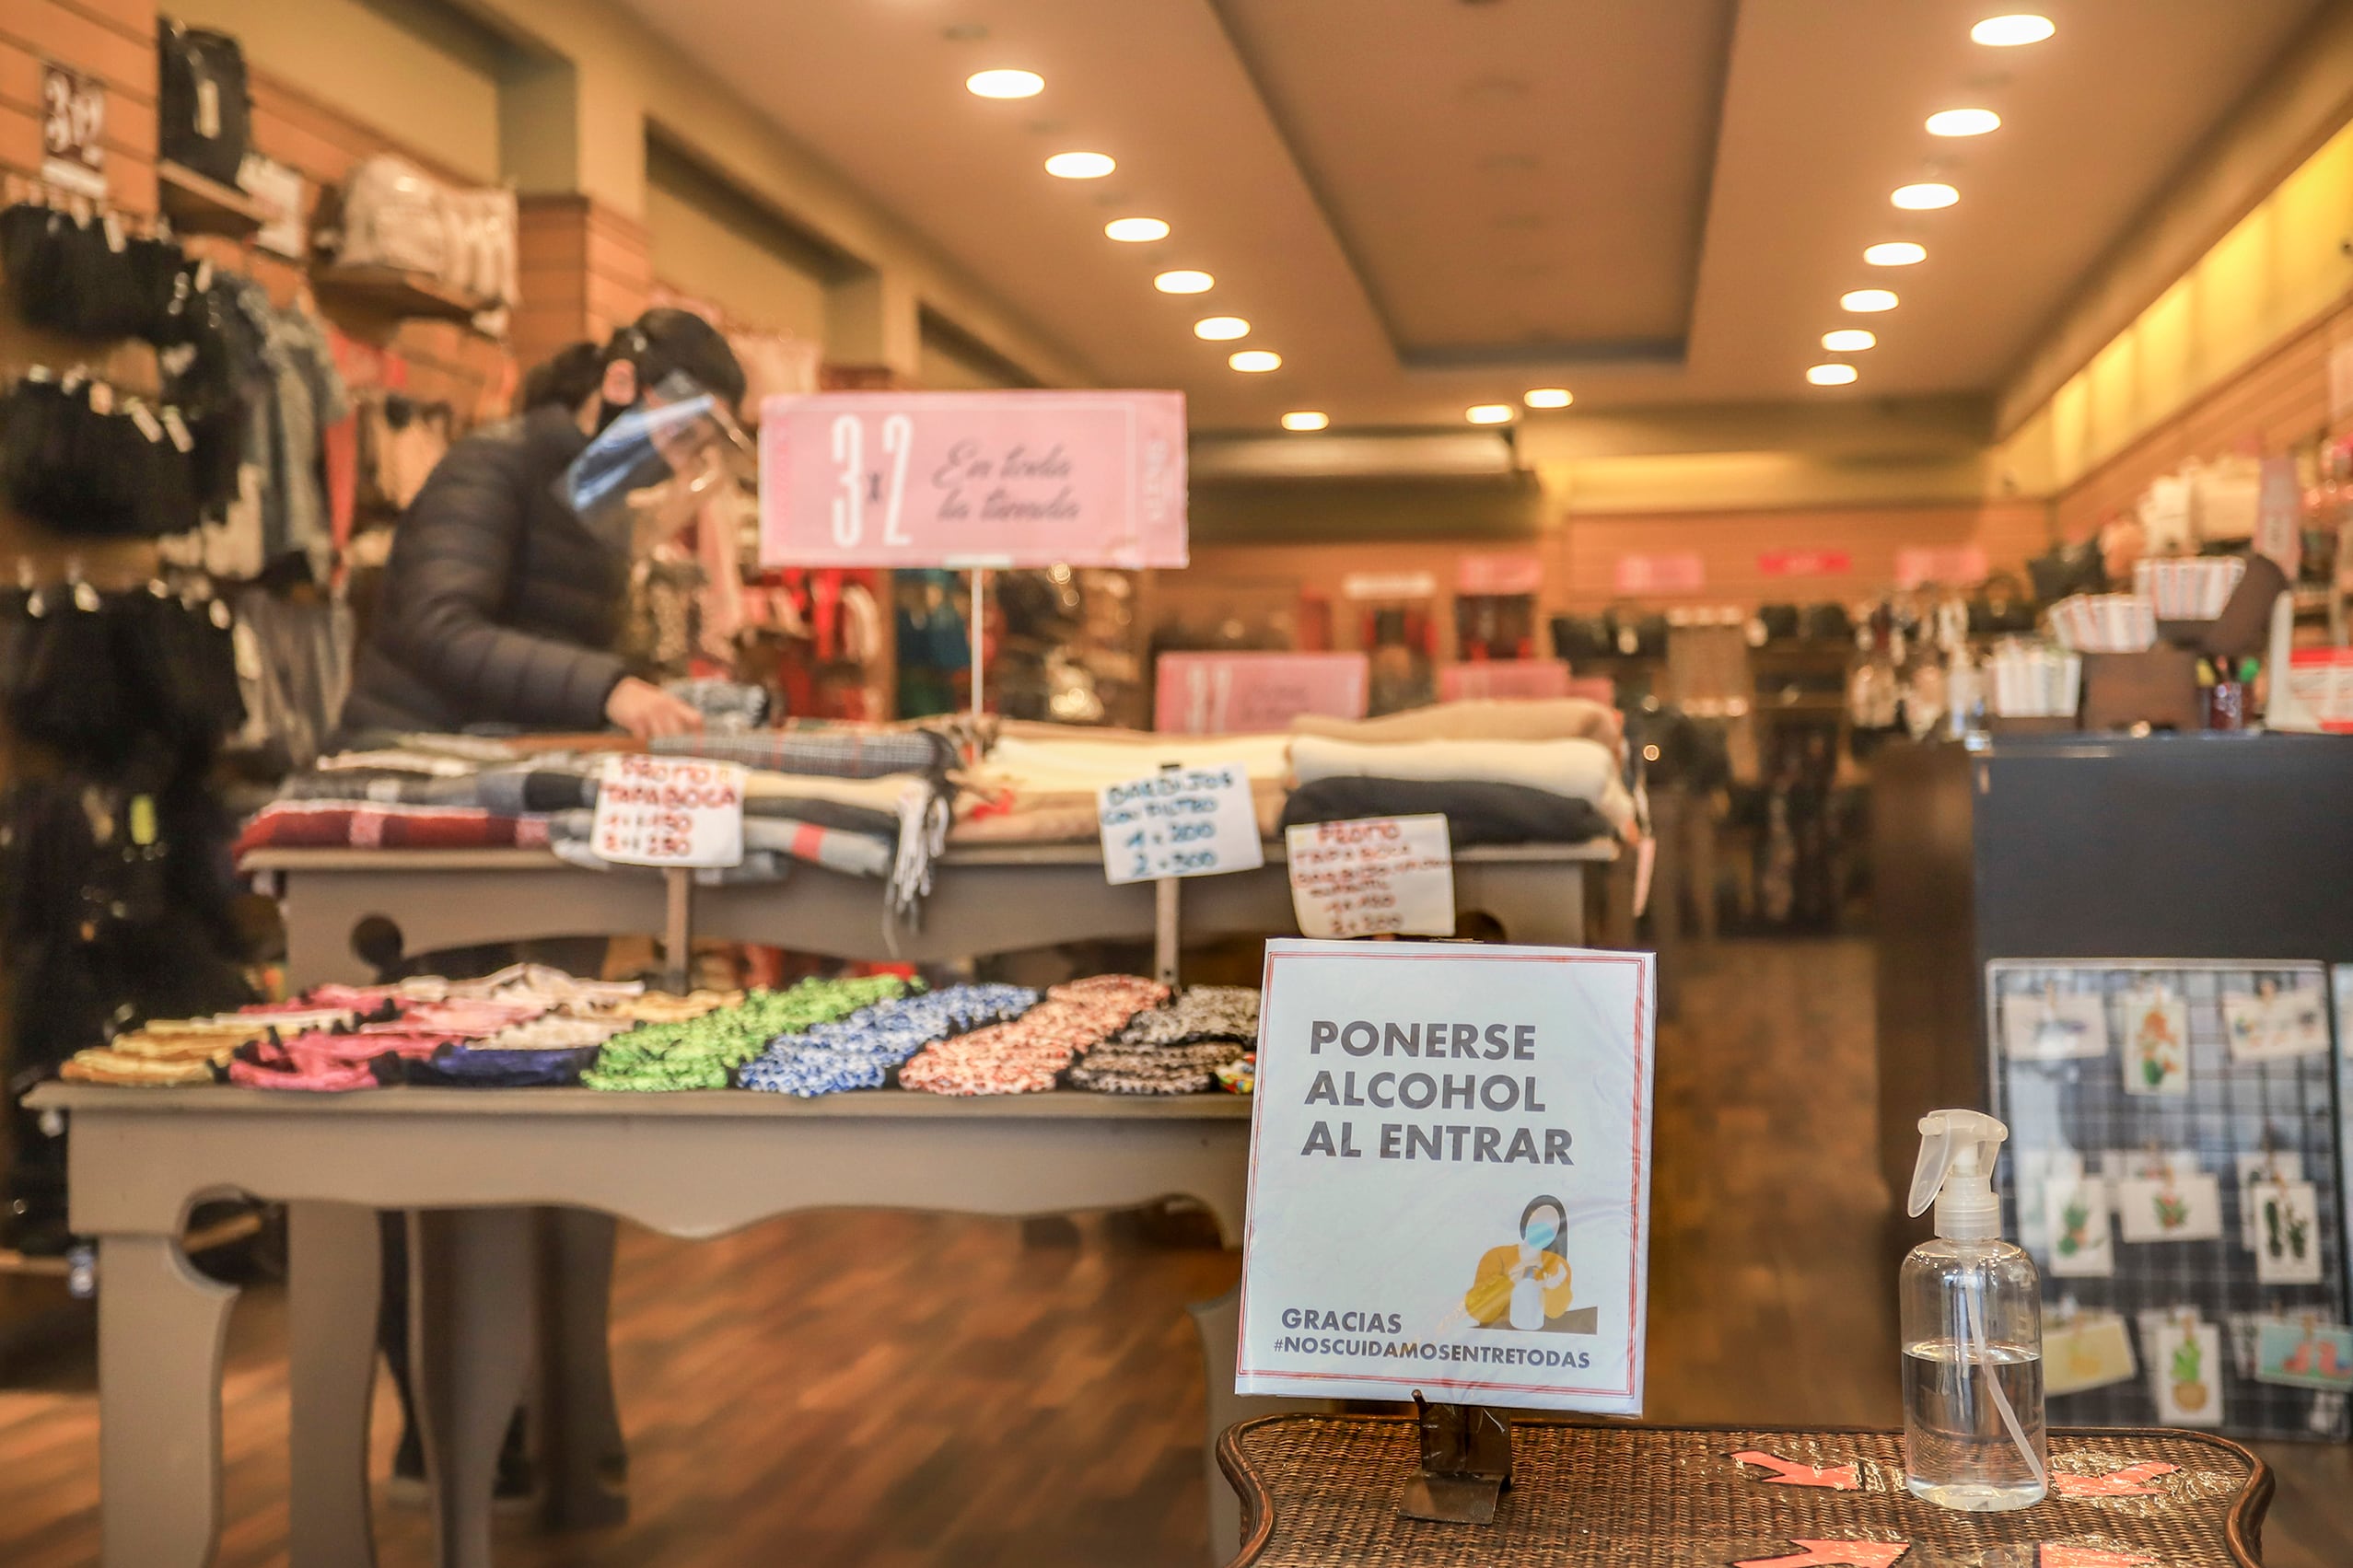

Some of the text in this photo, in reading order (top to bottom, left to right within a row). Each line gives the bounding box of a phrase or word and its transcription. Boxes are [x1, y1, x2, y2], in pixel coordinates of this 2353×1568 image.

[1310, 1020, 1536, 1061] PONERSE
[1304, 1070, 1546, 1112] ALCOHOL
[1300, 1121, 1575, 1166] AL ENTRAR
[1281, 1307, 1402, 1335] GRACIAS
[1274, 1336, 1591, 1369] #NOSCUIDAMOSENTRETODAS
